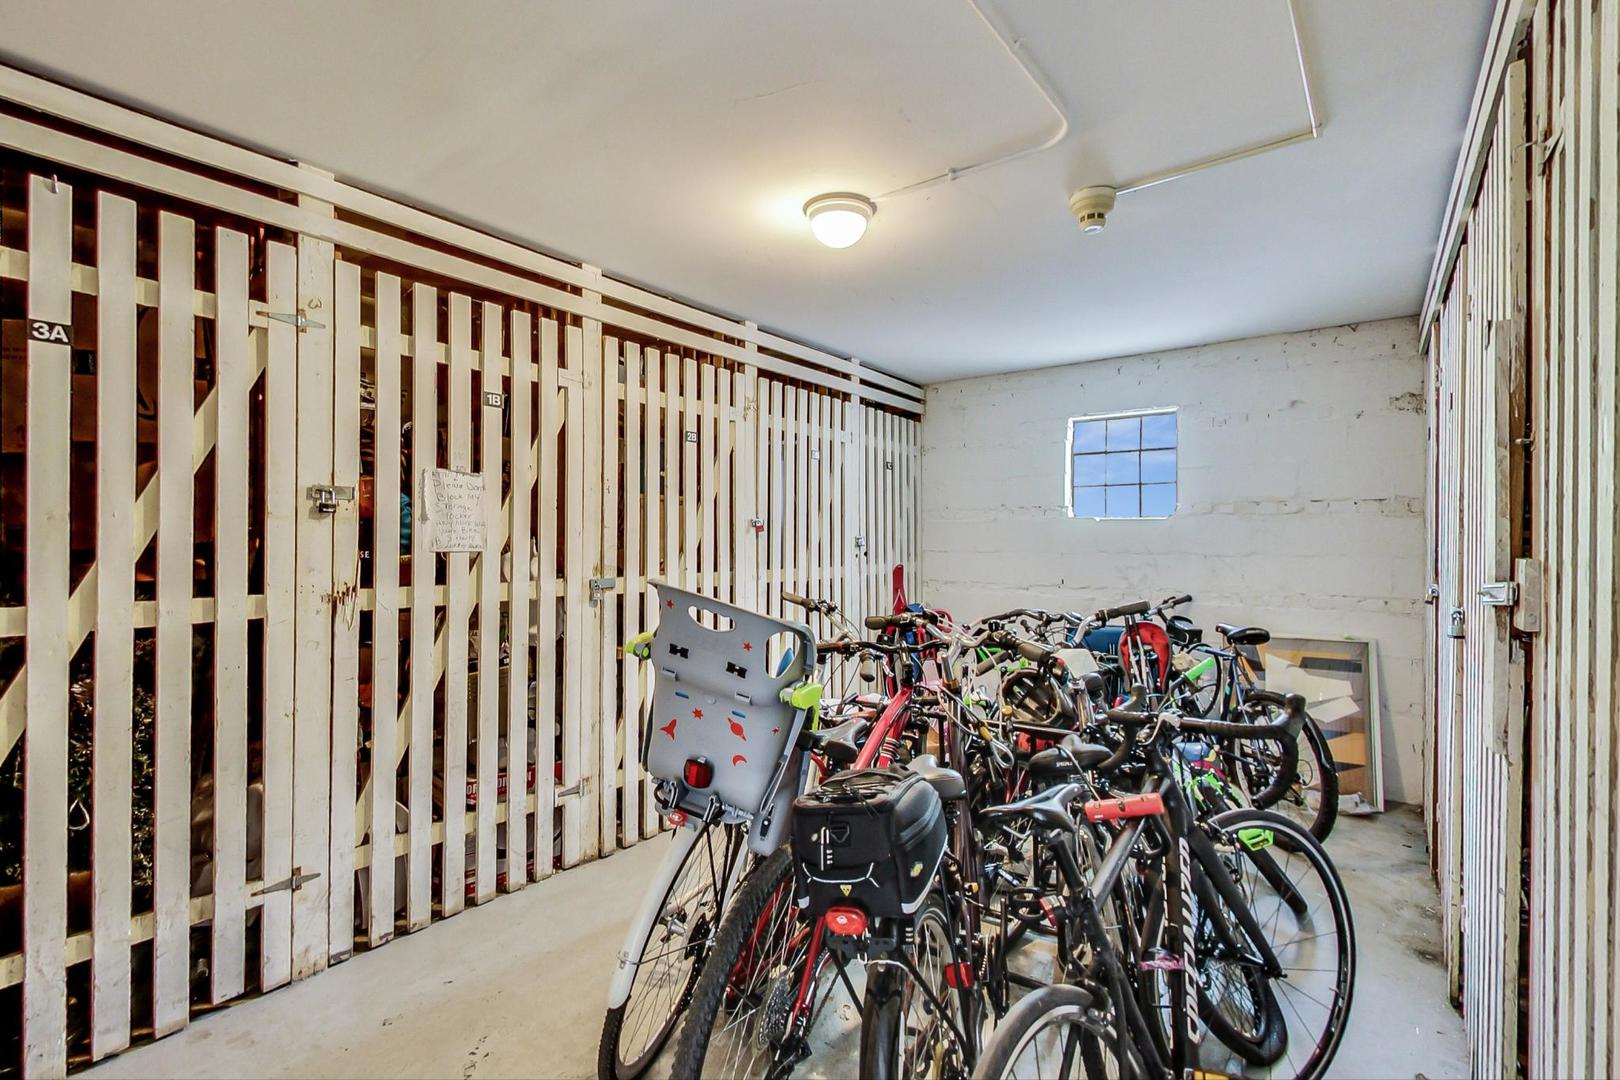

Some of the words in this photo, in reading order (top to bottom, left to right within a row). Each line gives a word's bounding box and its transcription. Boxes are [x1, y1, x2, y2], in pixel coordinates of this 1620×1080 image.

[32, 322, 69, 343] 3A
[487, 394, 501, 406] 1B
[687, 432, 697, 441] 2B
